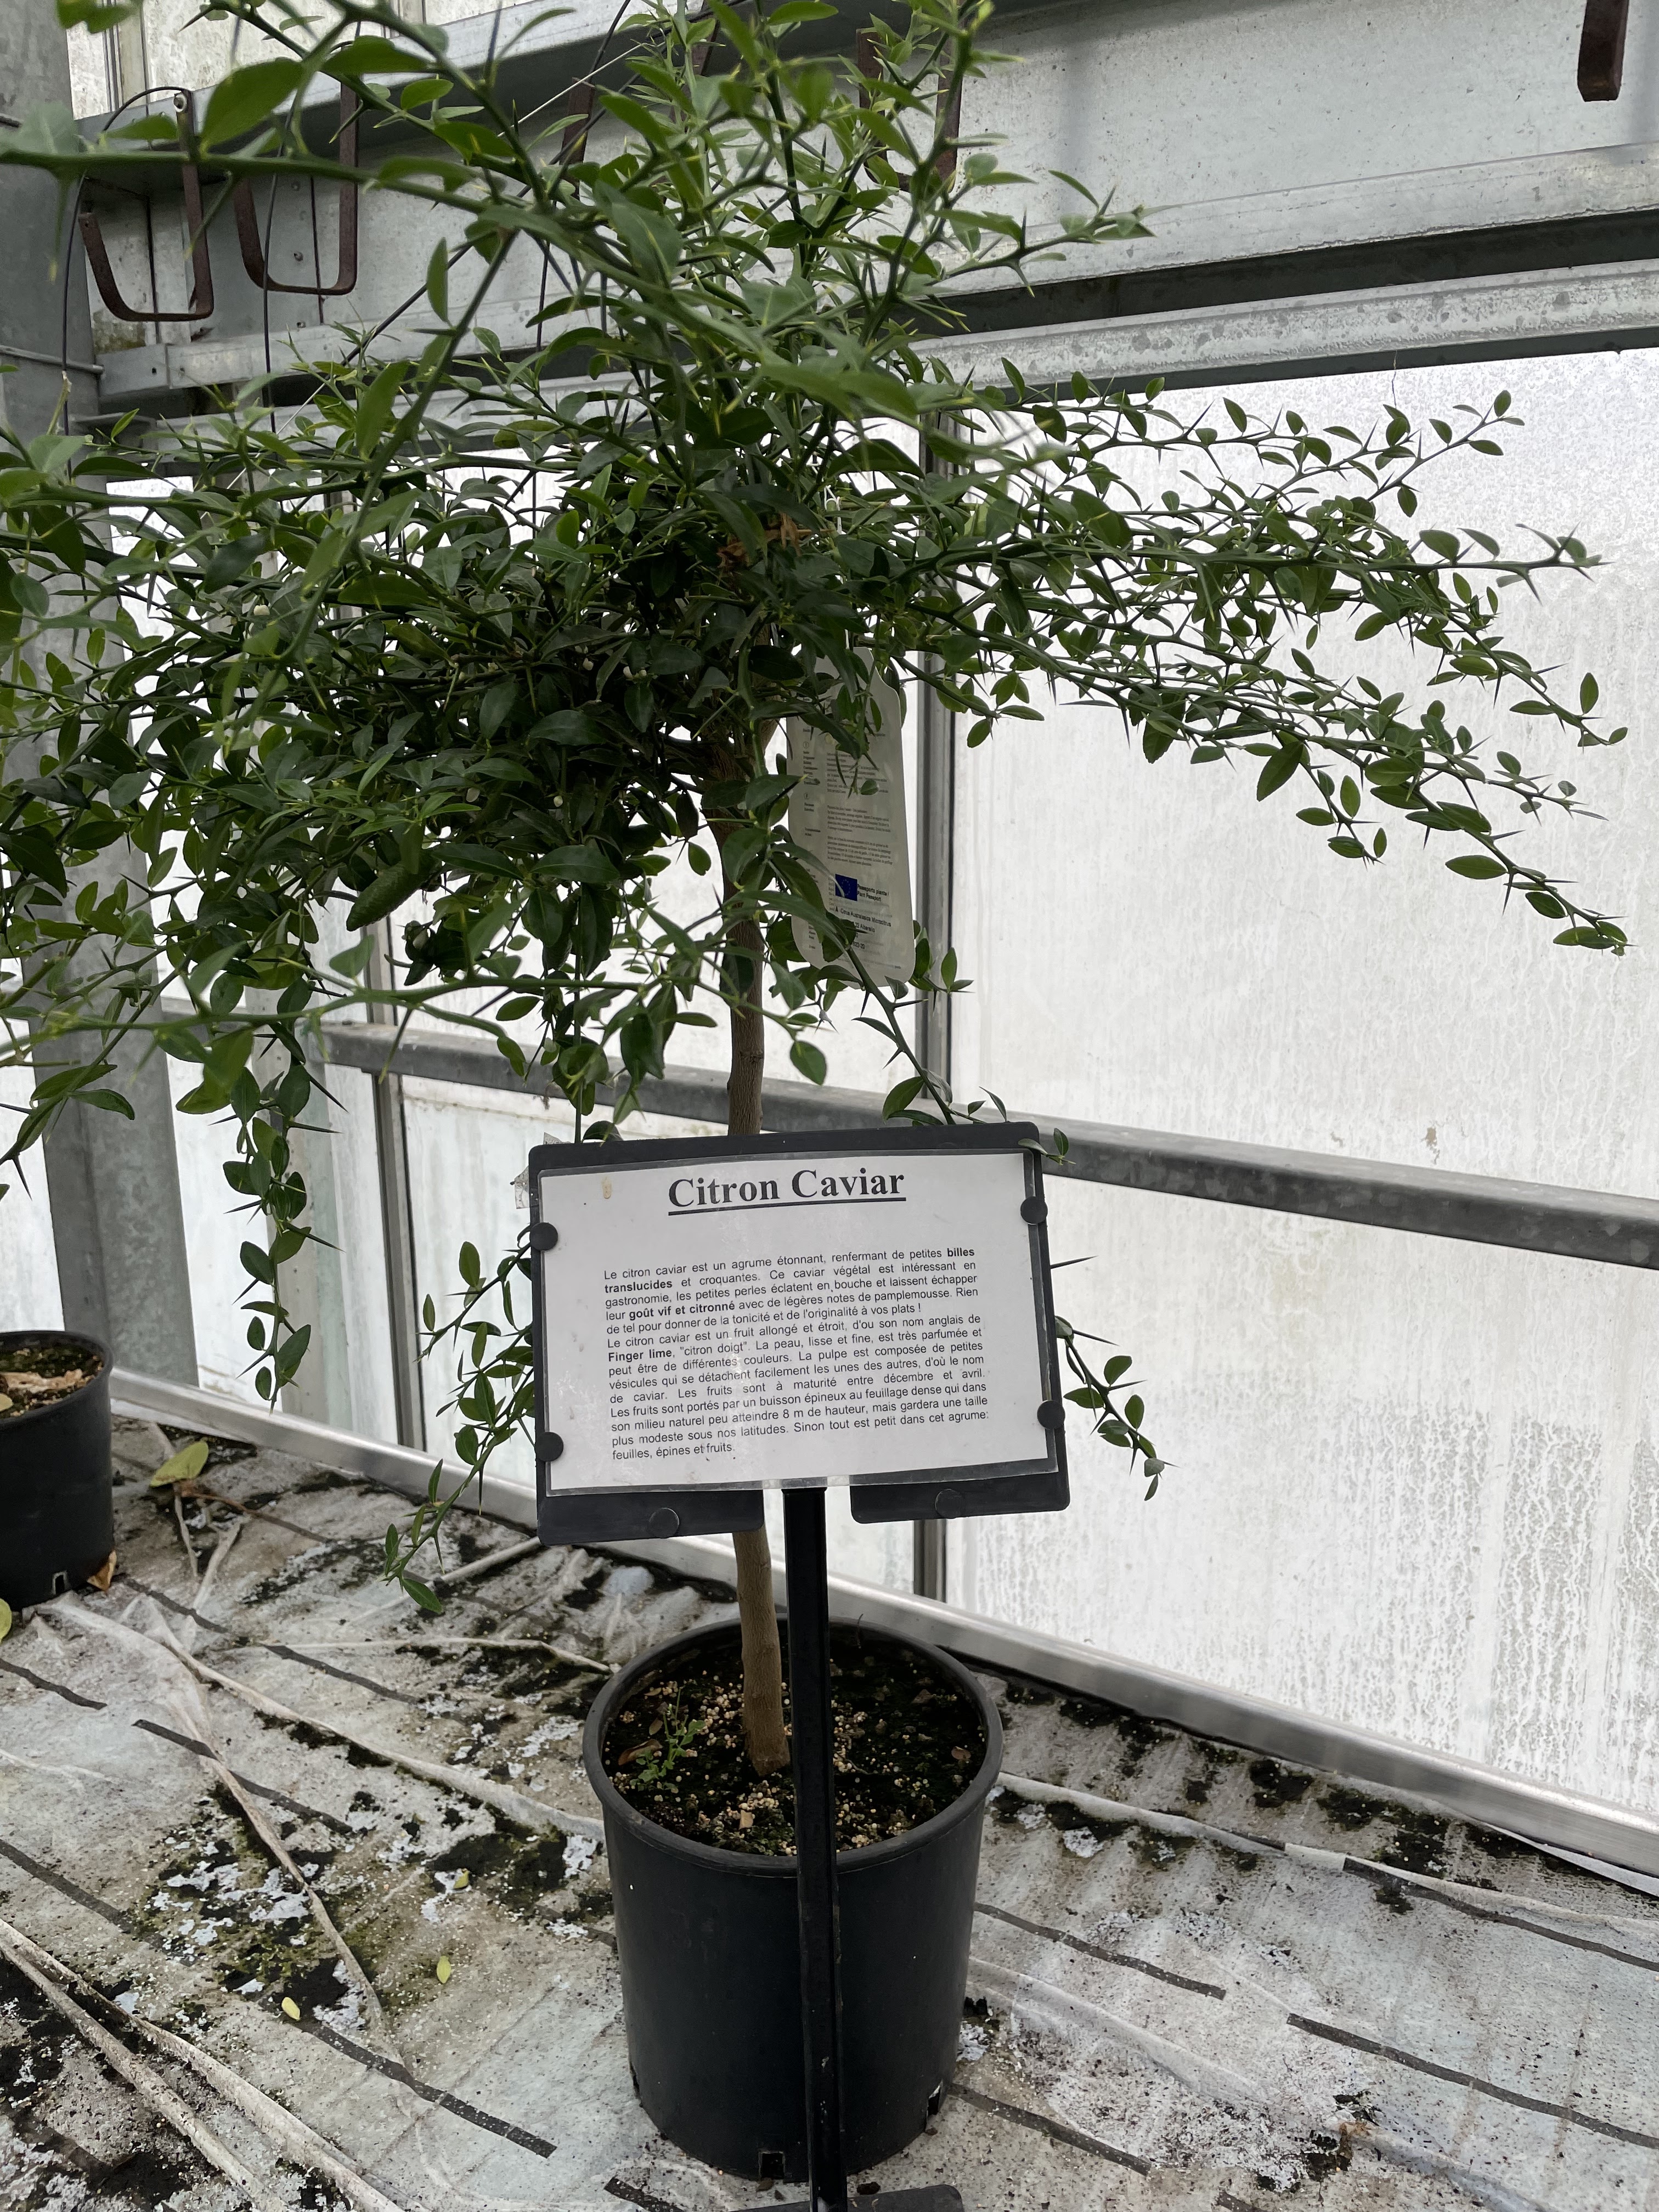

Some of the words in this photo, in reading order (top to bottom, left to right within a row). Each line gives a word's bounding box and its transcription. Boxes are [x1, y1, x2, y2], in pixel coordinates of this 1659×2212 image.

[668, 1177, 781, 1207] Citron
[791, 1167, 905, 1198] Caviar
[603, 1269, 617, 1280] Le
[622, 1268, 651, 1279] citron
[655, 1264, 687, 1276] caviar
[691, 1262, 709, 1273] est
[713, 1262, 726, 1271] un
[731, 1259, 772, 1271] agrume
[776, 1254, 827, 1266] étonnant,
[831, 1250, 888, 1263] renfermant
[891, 1249, 905, 1260] de
[909, 1248, 943, 1261] petites
[946, 1246, 975, 1257] billes
[604, 1279, 673, 1294] translucides
[680, 1277, 692, 1288] et
[699, 1272, 761, 1286] croquantes.
[769, 1269, 785, 1280] Ce
[793, 1267, 826, 1278] caviar
[832, 1263, 871, 1278] végétal
[878, 1263, 895, 1274] est
[901, 1261, 957, 1273] intéressant
[963, 1262, 977, 1271] en
[605, 1293, 672, 1310] gastronomie,
[676, 1291, 692, 1301] les
[695, 1288, 731, 1302] petites
[734, 1285, 767, 1299] perles
[770, 1281, 814, 1294] éclatent
[834, 1278, 873, 1290] bouche
[876, 1277, 887, 1288] et
[889, 1276, 928, 1287] laissent
[931, 1274, 978, 1286] échapper
[606, 1311, 627, 1321] leur
[628, 1307, 654, 1322] goût
[657, 1305, 672, 1317] vif
[675, 1305, 686, 1316] et
[689, 1300, 736, 1314] citronné
[738, 1300, 765, 1310] avec
[766, 1297, 781, 1308] de
[783, 1295, 823, 1308] légères
[826, 1293, 855, 1304] notes
[857, 1291, 872, 1302] de
[874, 1289, 952, 1304] pamplemousse.
[955, 1286, 979, 1297] Rien
[606, 1324, 620, 1335] de
[622, 1322, 635, 1334] tel
[638, 1322, 662, 1334] pour
[664, 1319, 702, 1330] donner
[703, 1316, 718, 1327] de
[720, 1315, 730, 1325] la
[731, 1311, 771, 1325] tonicité
[772, 1311, 785, 1321] et
[786, 1309, 800, 1321] de
[803, 1305, 859, 1321] l'originalité
[861, 1305, 868, 1316] à
[870, 1306, 889, 1315] vos
[891, 1303, 916, 1317] plats
[607, 1338, 621, 1349] Le
[625, 1336, 654, 1347] citron
[659, 1332, 691, 1345] caviar
[695, 1330, 712, 1341] est
[715, 1331, 729, 1340] un
[733, 1327, 755, 1338] fruit
[759, 1323, 798, 1337] allongé
[803, 1323, 814, 1333] et
[817, 1321, 848, 1332] étroit,
[852, 1319, 874, 1330] d'ou
[878, 1319, 898, 1329] son
[902, 1318, 924, 1327] nom
[928, 1314, 964, 1328] anglais
[968, 1313, 981, 1324] de
[608, 1351, 645, 1363] Finger
[648, 1348, 675, 1359] lime,
[679, 1345, 713, 1356] "citron
[717, 1341, 751, 1355] doigt".
[755, 1340, 769, 1351] La
[774, 1339, 804, 1352] peau,
[808, 1336, 833, 1347] lisse
[837, 1334, 848, 1345] et
[851, 1333, 874, 1344] fine,
[878, 1331, 894, 1342] est
[898, 1330, 917, 1341] très
[921, 1327, 968, 1342] parfumée
[972, 1327, 983, 1338] et
[608, 1364, 633, 1379] peut
[637, 1363, 658, 1374] être
[663, 1361, 677, 1372] de
[682, 1357, 738, 1370] différentes
[743, 1353, 793, 1365] couleurs.
[798, 1351, 812, 1362] La
[818, 1348, 848, 1362] pulpe
[853, 1347, 870, 1358] est
[874, 1343, 927, 1358] composée
[932, 1342, 945, 1353] de
[950, 1341, 983, 1355] petites
[610, 1407, 630, 1418] Les
[633, 1405, 659, 1417] fruits
[661, 1402, 685, 1414] sont
[686, 1400, 720, 1415] portés
[722, 1400, 741, 1412] par
[742, 1399, 757, 1408] un
[759, 1395, 802, 1407] buisson
[804, 1391, 847, 1406] épineux
[849, 1391, 863, 1400] au
[865, 1387, 909, 1400] feuillage
[911, 1385, 942, 1396] dense
[944, 1383, 960, 1396] qui
[962, 1382, 987, 1393] dans
[611, 1423, 631, 1432] son
[634, 1419, 665, 1430] milieu
[669, 1414, 705, 1428] naturel
[708, 1415, 729, 1427] peu
[731, 1409, 779, 1423] atteindre
[782, 1408, 790, 1419] 8
[793, 1409, 804, 1418] m
[807, 1406, 822, 1418] de
[825, 1404, 868, 1416] hauteur,
[872, 1401, 897, 1413] mais
[900, 1398, 940, 1413] gardera
[942, 1398, 962, 1408] une
[964, 1395, 988, 1407] taille
[612, 1435, 634, 1449] plus
[639, 1431, 684, 1444] modeste
[687, 1431, 713, 1441] sous
[717, 1429, 737, 1438] nos
[740, 1424, 789, 1437] latitudes.
[793, 1421, 825, 1433] Sinon
[829, 1419, 850, 1430] tout
[853, 1417, 871, 1429] est
[874, 1415, 897, 1429] petit
[900, 1414, 926, 1425] dans
[928, 1412, 945, 1423] cet
[612, 1448, 653, 1460] feuilles,
[656, 1446, 691, 1459] épines
[693, 1443, 704, 1454] et
[706, 1442, 735, 1453] fruits.
